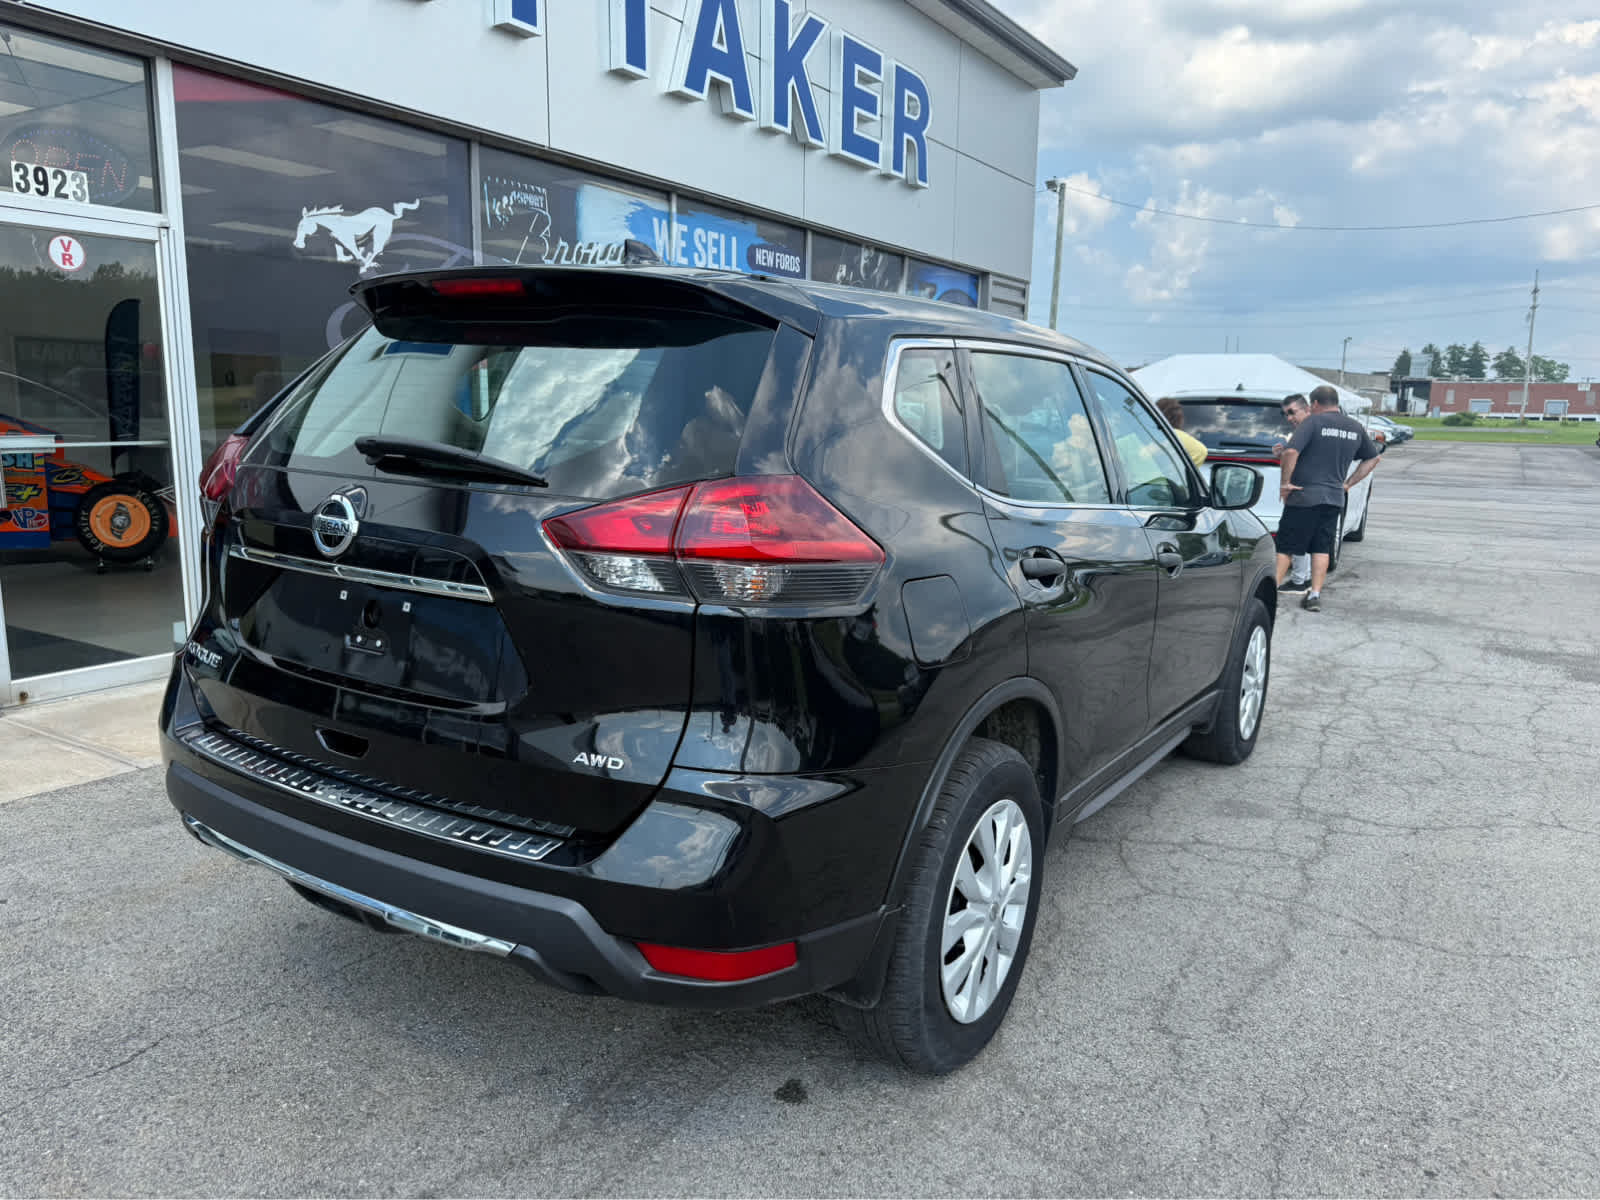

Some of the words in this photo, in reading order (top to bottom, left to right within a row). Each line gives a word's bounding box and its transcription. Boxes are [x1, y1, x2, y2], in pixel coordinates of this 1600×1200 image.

[14, 163, 87, 202] 3923
[59, 239, 73, 253] V
[653, 216, 688, 265] WE
[693, 227, 742, 272] SELL
[61, 253, 75, 267] R
[755, 247, 775, 267] NEW
[775, 252, 801, 273] FORDS
[1339, 430, 1347, 439] TO
[572, 751, 625, 770] AWD
